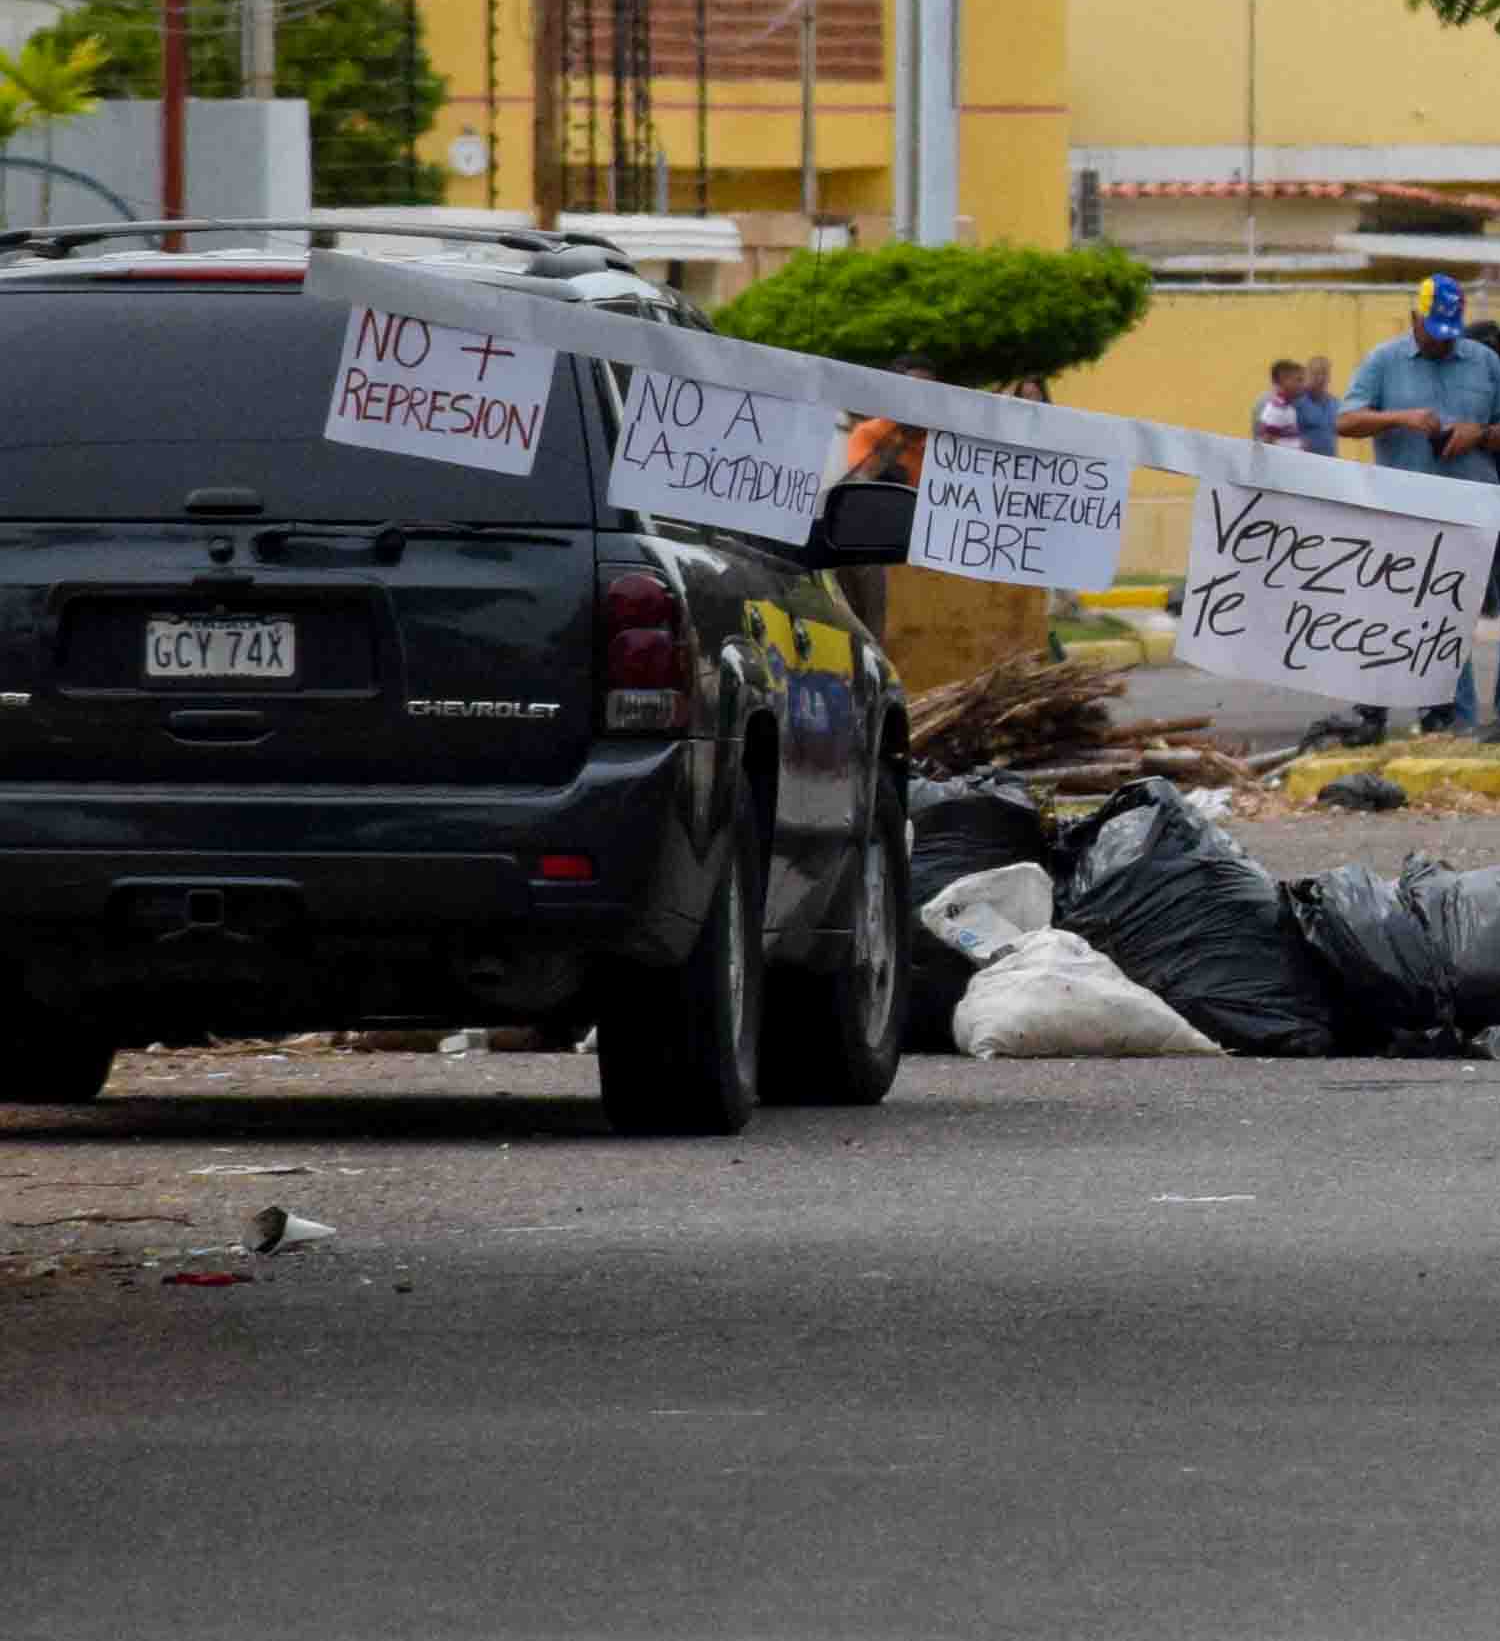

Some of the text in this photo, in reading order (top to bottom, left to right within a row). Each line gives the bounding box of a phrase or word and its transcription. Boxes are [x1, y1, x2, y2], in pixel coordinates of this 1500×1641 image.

[355, 307, 516, 382] NO +
[338, 367, 541, 451] REPRESION
[637, 374, 763, 445] NO A
[623, 422, 674, 471] LA
[933, 430, 1110, 492] QUEREMOS
[928, 478, 1121, 530] UNA VENEZUELA
[924, 510, 1047, 575] LIBRE
[1210, 488, 1466, 613] Venezuela
[154, 630, 284, 669] GCY 74X
[1191, 570, 1464, 678] Te necesita
[407, 700, 560, 719] CHEVROLET
